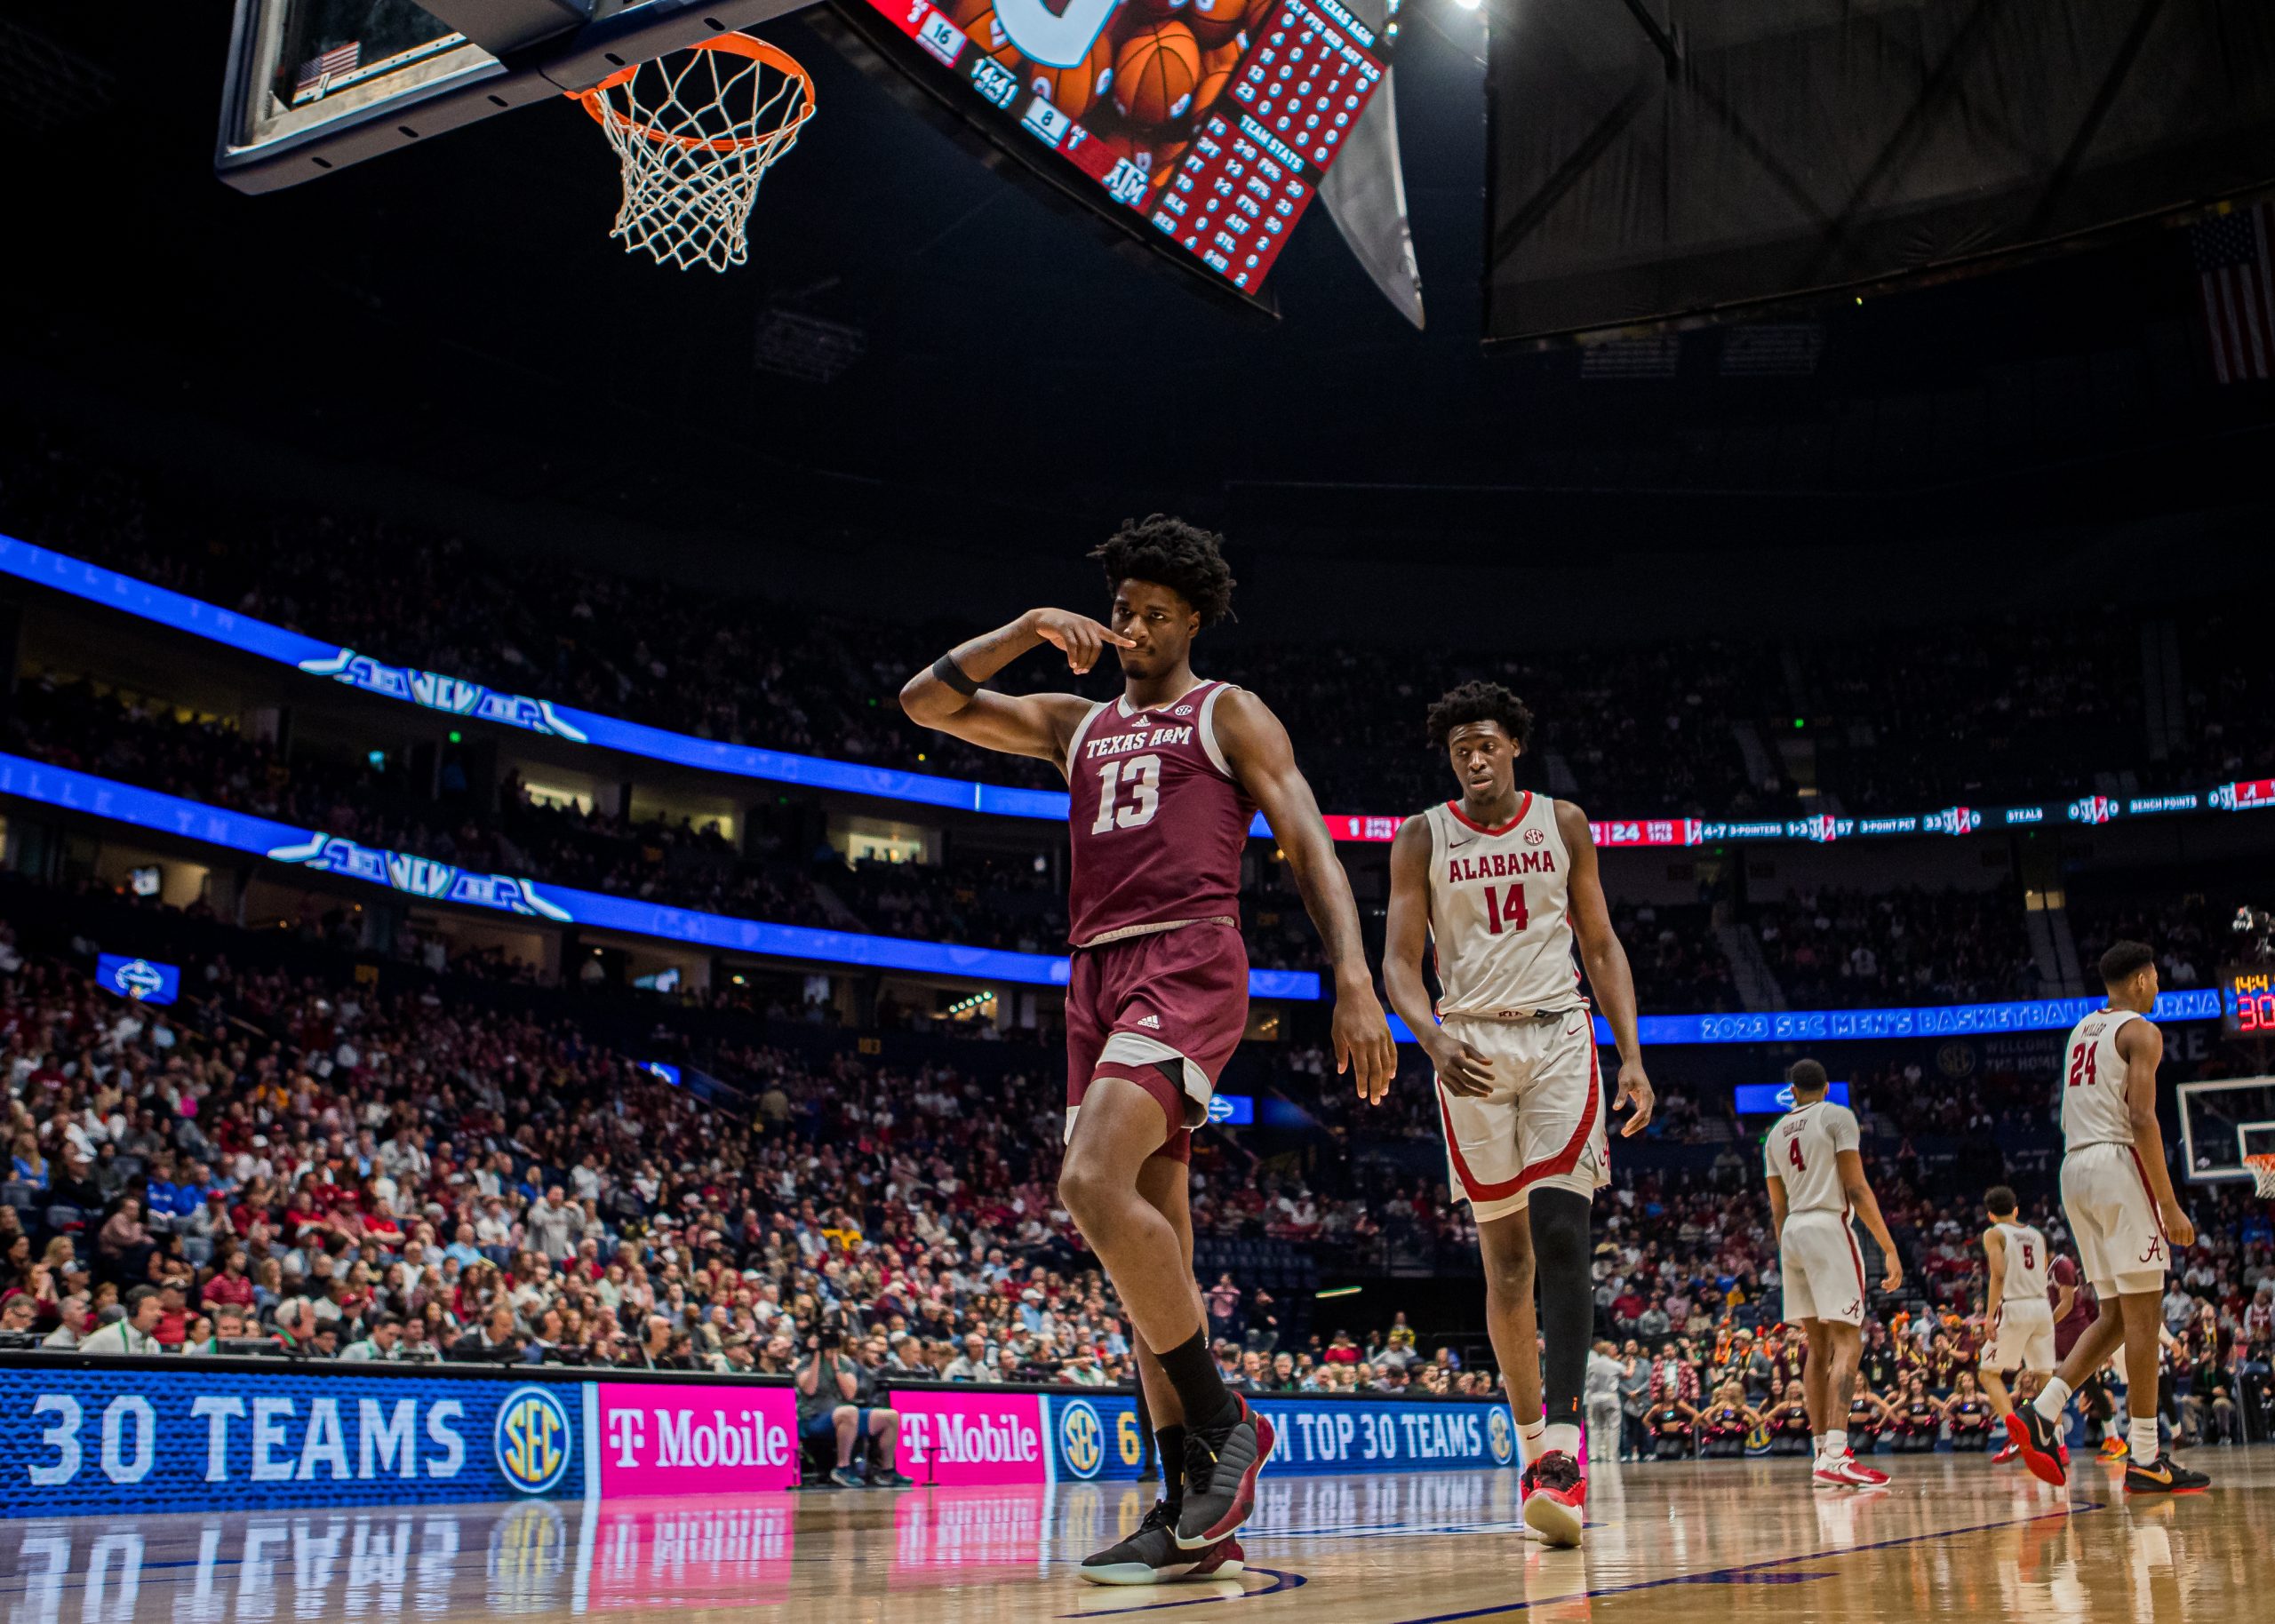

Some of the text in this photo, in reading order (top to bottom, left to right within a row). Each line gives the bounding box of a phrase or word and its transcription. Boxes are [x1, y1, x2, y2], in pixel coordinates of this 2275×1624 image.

[934, 22, 953, 44] 16
[1281, 13, 1369, 92] 0 4 1 1 0
[971, 58, 1019, 102] 14:41
[1271, 32, 1358, 109] 4 0 1 1 0
[1269, 83, 1282, 97] 0
[1287, 99, 1301, 113] 0
[1305, 115, 1320, 129] 0
[1324, 130, 1338, 144] 0
[1279, 66, 1293, 79] 0
[1297, 81, 1312, 95] 0
[1316, 97, 1329, 111] 0
[1335, 112, 1348, 127] 0
[1042, 110, 1054, 126] 8
[1258, 100, 1272, 115] 0
[1277, 116, 1290, 131] 0
[1296, 131, 1309, 146] 0
[1314, 147, 1328, 162] 0
[1240, 115, 1305, 172] TEAM STATS
[1087, 725, 1193, 759] TEXAS A&M
[1092, 754, 1160, 835] 13
[2130, 798, 2163, 813] BENCH
[2162, 794, 2198, 810] POINTS
[1348, 817, 1360, 837] 1
[1611, 823, 1641, 842] 24
[1704, 823, 1727, 839] 4-7
[1786, 821, 1808, 837] 1-3
[2007, 808, 2043, 823] STEALS
[1526, 829, 1543, 845] SEC
[1449, 850, 1556, 883] ALABAMA
[1484, 884, 1529, 934] 14
[2235, 974, 2275, 995] 14:4
[1138, 1020, 1160, 1030] adidas
[1701, 1016, 1769, 1039] 2023
[1776, 1015, 1827, 1038] SEC
[1832, 1008, 1912, 1036] MEN'S
[1919, 1000, 2087, 1032] BASKETBALL
[2238, 993, 2275, 1031] 30
[2069, 1040, 2098, 1087] 24
[1790, 1137, 1807, 1172] 4
[2024, 1244, 2035, 1270] 5
[28, 1395, 466, 1485] 30 TEAMS
[504, 1397, 562, 1482] SEC
[609, 1408, 789, 1468] T Mobile
[935, 1413, 1038, 1463] Mobile
[1065, 1409, 1141, 1470] SEC 6
[1297, 1413, 1354, 1461] TOP
[1361, 1413, 1397, 1460] 30
[1401, 1413, 1482, 1459] TEAMS
